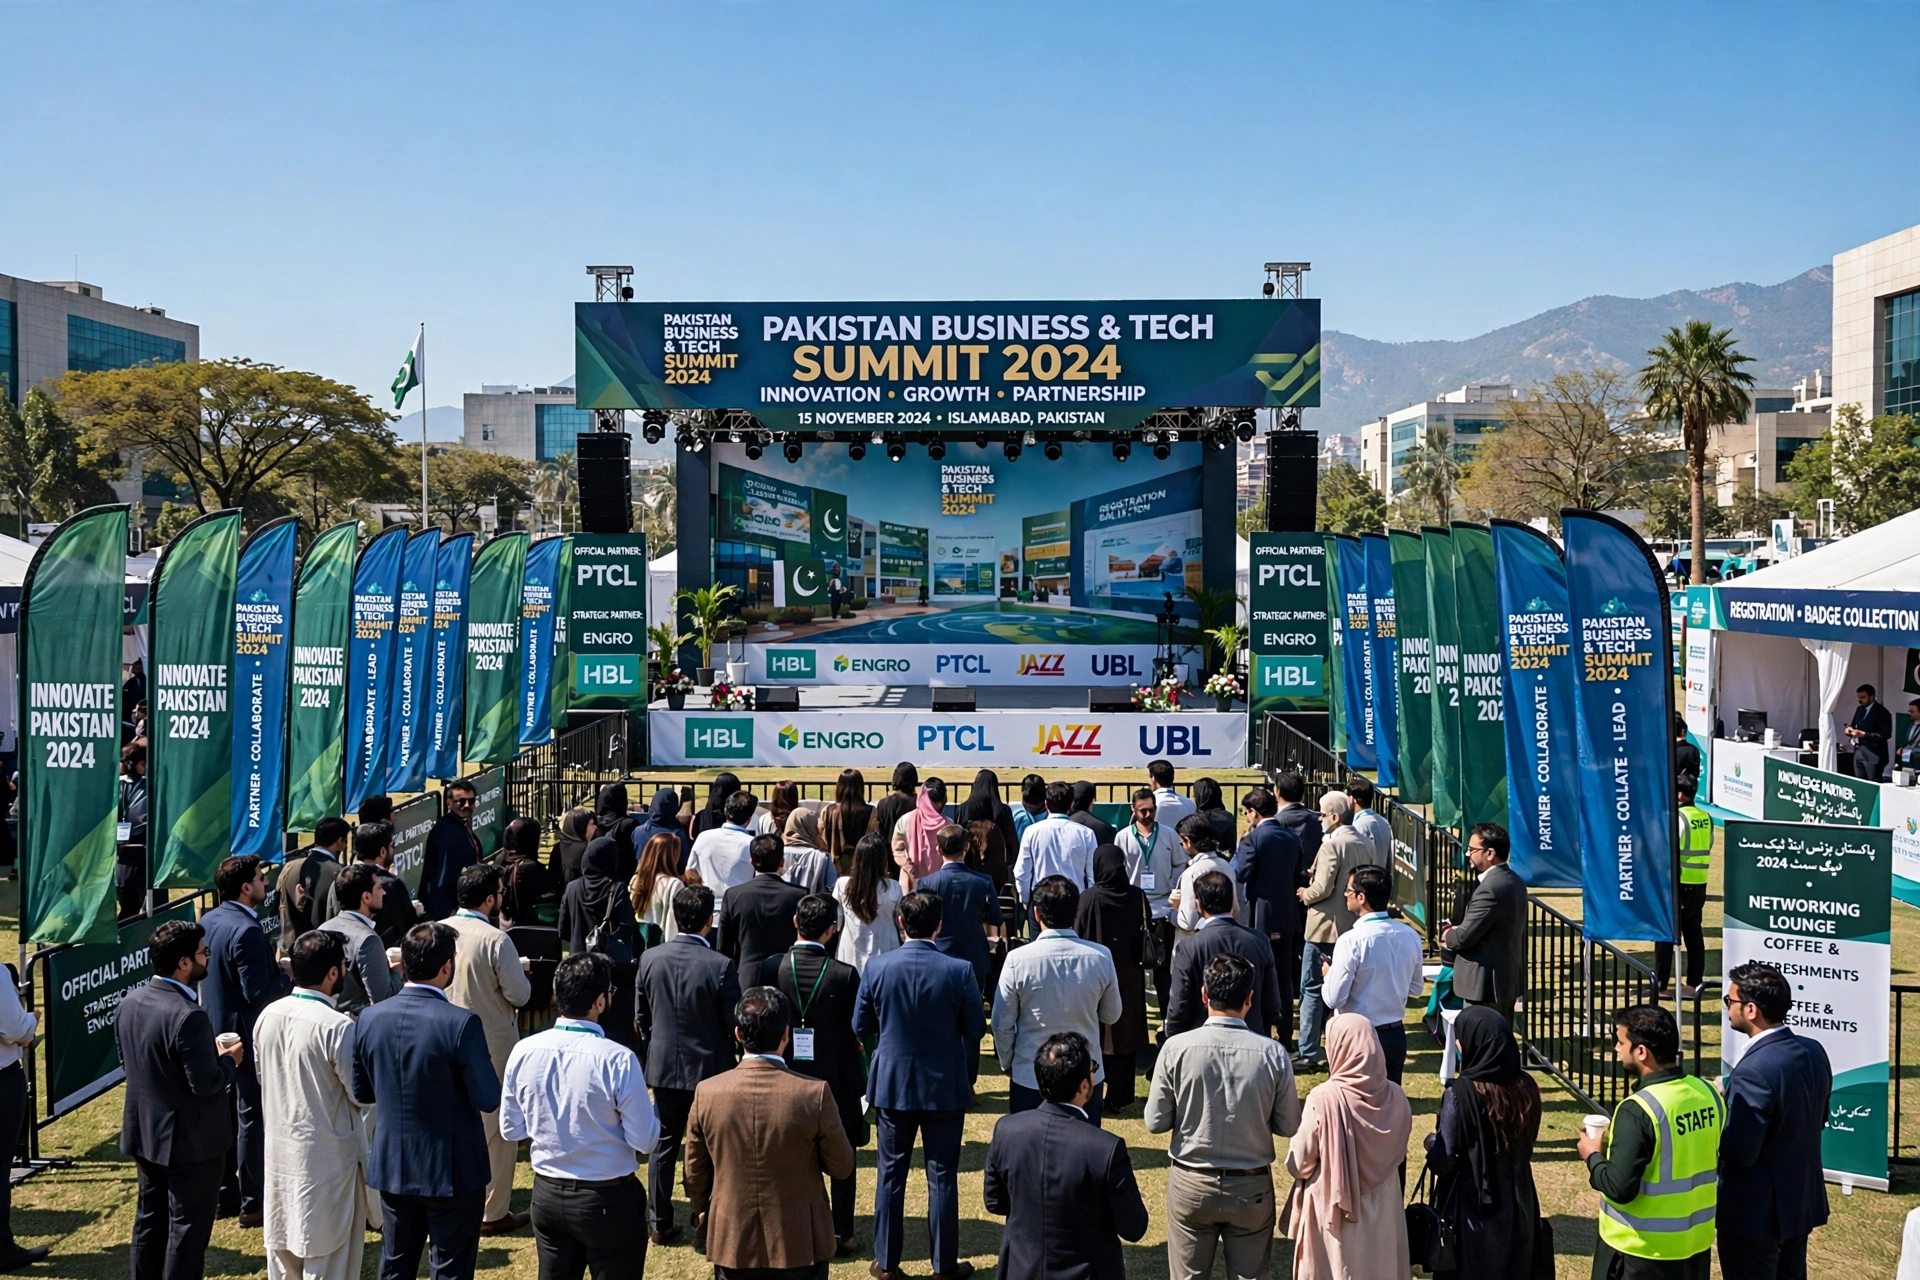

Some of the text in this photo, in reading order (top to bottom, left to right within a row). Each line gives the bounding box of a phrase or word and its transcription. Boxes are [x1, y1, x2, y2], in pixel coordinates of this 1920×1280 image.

[664, 314, 732, 326] PAKISTAN
[763, 313, 1213, 341] PAKISTAN BUSINESS & TECH
[664, 327, 739, 339] BUSINESS
[664, 340, 720, 353] & TECH
[664, 354, 739, 369] SUMMIT
[792, 344, 1121, 382] SUMMIT 2024
[664, 369, 711, 385] 2024
[760, 385, 1146, 402] INNOVATION GROWTH PARTNERSHIP
[797, 411, 1105, 426] 15 NOVEMBER 2024 ISLAMABAD, PAKISTAN
[941, 465, 990, 475] PAKISTAN
[941, 474, 995, 484] BUSINESS
[941, 484, 982, 494] & TECH
[941, 493, 995, 505] SUMMIT
[941, 504, 976, 515] 2024
[574, 547, 606, 556] OFFICIAL
[1255, 546, 1288, 555] OFFICIAL
[577, 565, 637, 586] PTCL
[1259, 564, 1321, 587] PTCL
[236, 604, 279, 614] PAKISTAN
[572, 610, 609, 619] STRATEGIC
[1253, 611, 1292, 620] STRATEGIC
[1730, 601, 1795, 623] REGISTRATION
[1804, 605, 1841, 626] BADGE
[1843, 608, 1919, 631] COLLECTION
[236, 613, 283, 624] BUSINESS
[1349, 621, 1369, 629] 202
[1509, 612, 1564, 624] PAKISTAN
[1582, 616, 1646, 629] PAKISTAN
[236, 623, 272, 633] & TECH
[355, 629, 381, 639] 2024
[468, 623, 514, 638] INNOVATE
[1377, 629, 1396, 638] 202
[1509, 623, 1569, 635] BUSINESS
[1582, 628, 1652, 641] BUSINESS
[236, 633, 283, 644] SUMMIT
[468, 638, 514, 654] PAKISTAN
[583, 632, 633, 645] ENGRO
[1264, 633, 1316, 646] ENGRO
[1402, 638, 1430, 655] INNO
[1510, 633, 1555, 645] & TECH
[236, 644, 268, 655] 2024
[1510, 644, 1570, 656] SUMMIT
[1584, 640, 1635, 654] & TECH
[294, 646, 343, 666] INNOVATE
[475, 655, 504, 671] 2024
[1463, 653, 1501, 674] INNO
[1511, 656, 1550, 669] 2024
[1584, 652, 1653, 667] SUMMIT
[368, 654, 377, 680] LEAD
[436, 641, 446, 705] COLLABORATE
[772, 653, 1143, 677] HBL ENGRO PTCL JAZZ UBL
[1363, 640, 1373, 701] COLLABORATE
[1402, 656, 1430, 674] PAKI
[158, 664, 227, 687] INNOVATE
[293, 667, 343, 686] PAKISTAN
[402, 646, 413, 717] COLLABORATE
[584, 665, 633, 684] HBL
[1264, 666, 1316, 686] HBL
[1585, 667, 1630, 682] 2024
[1414, 676, 1431, 695] 20
[1464, 676, 1502, 697] PAKIS
[31, 683, 115, 709] INNOVATE
[157, 689, 227, 712] PAKISTAN
[300, 688, 330, 708] 2024
[1478, 700, 1504, 721] 202
[30, 711, 115, 738] PAKISTAN
[169, 715, 210, 739] 2024
[693, 721, 1212, 756] HBL ENGRO PTCL JAZZ UBL
[46, 742, 96, 769] 2024
[249, 673, 263, 828] PARTNER COLLABORATE
[1535, 685, 1553, 851] PARTNER COLLABORATE
[1613, 702, 1634, 901] PARTNER COLLATE LEAD
[1834, 843, 1876, 861] پاکستان
[1756, 856, 1788, 869] 2024
[1749, 895, 1860, 917] NETWORKING
[1769, 915, 1836, 934] LOUNGE
[1764, 937, 1840, 956] COFFEE &
[62, 961, 119, 1001] OFFICIAL
[121, 947, 152, 975] PART
[1823, 1003, 1834, 1015] &
[1783, 1014, 1858, 1033] ESHMENTS
[1675, 1106, 1716, 1136] STAFF
